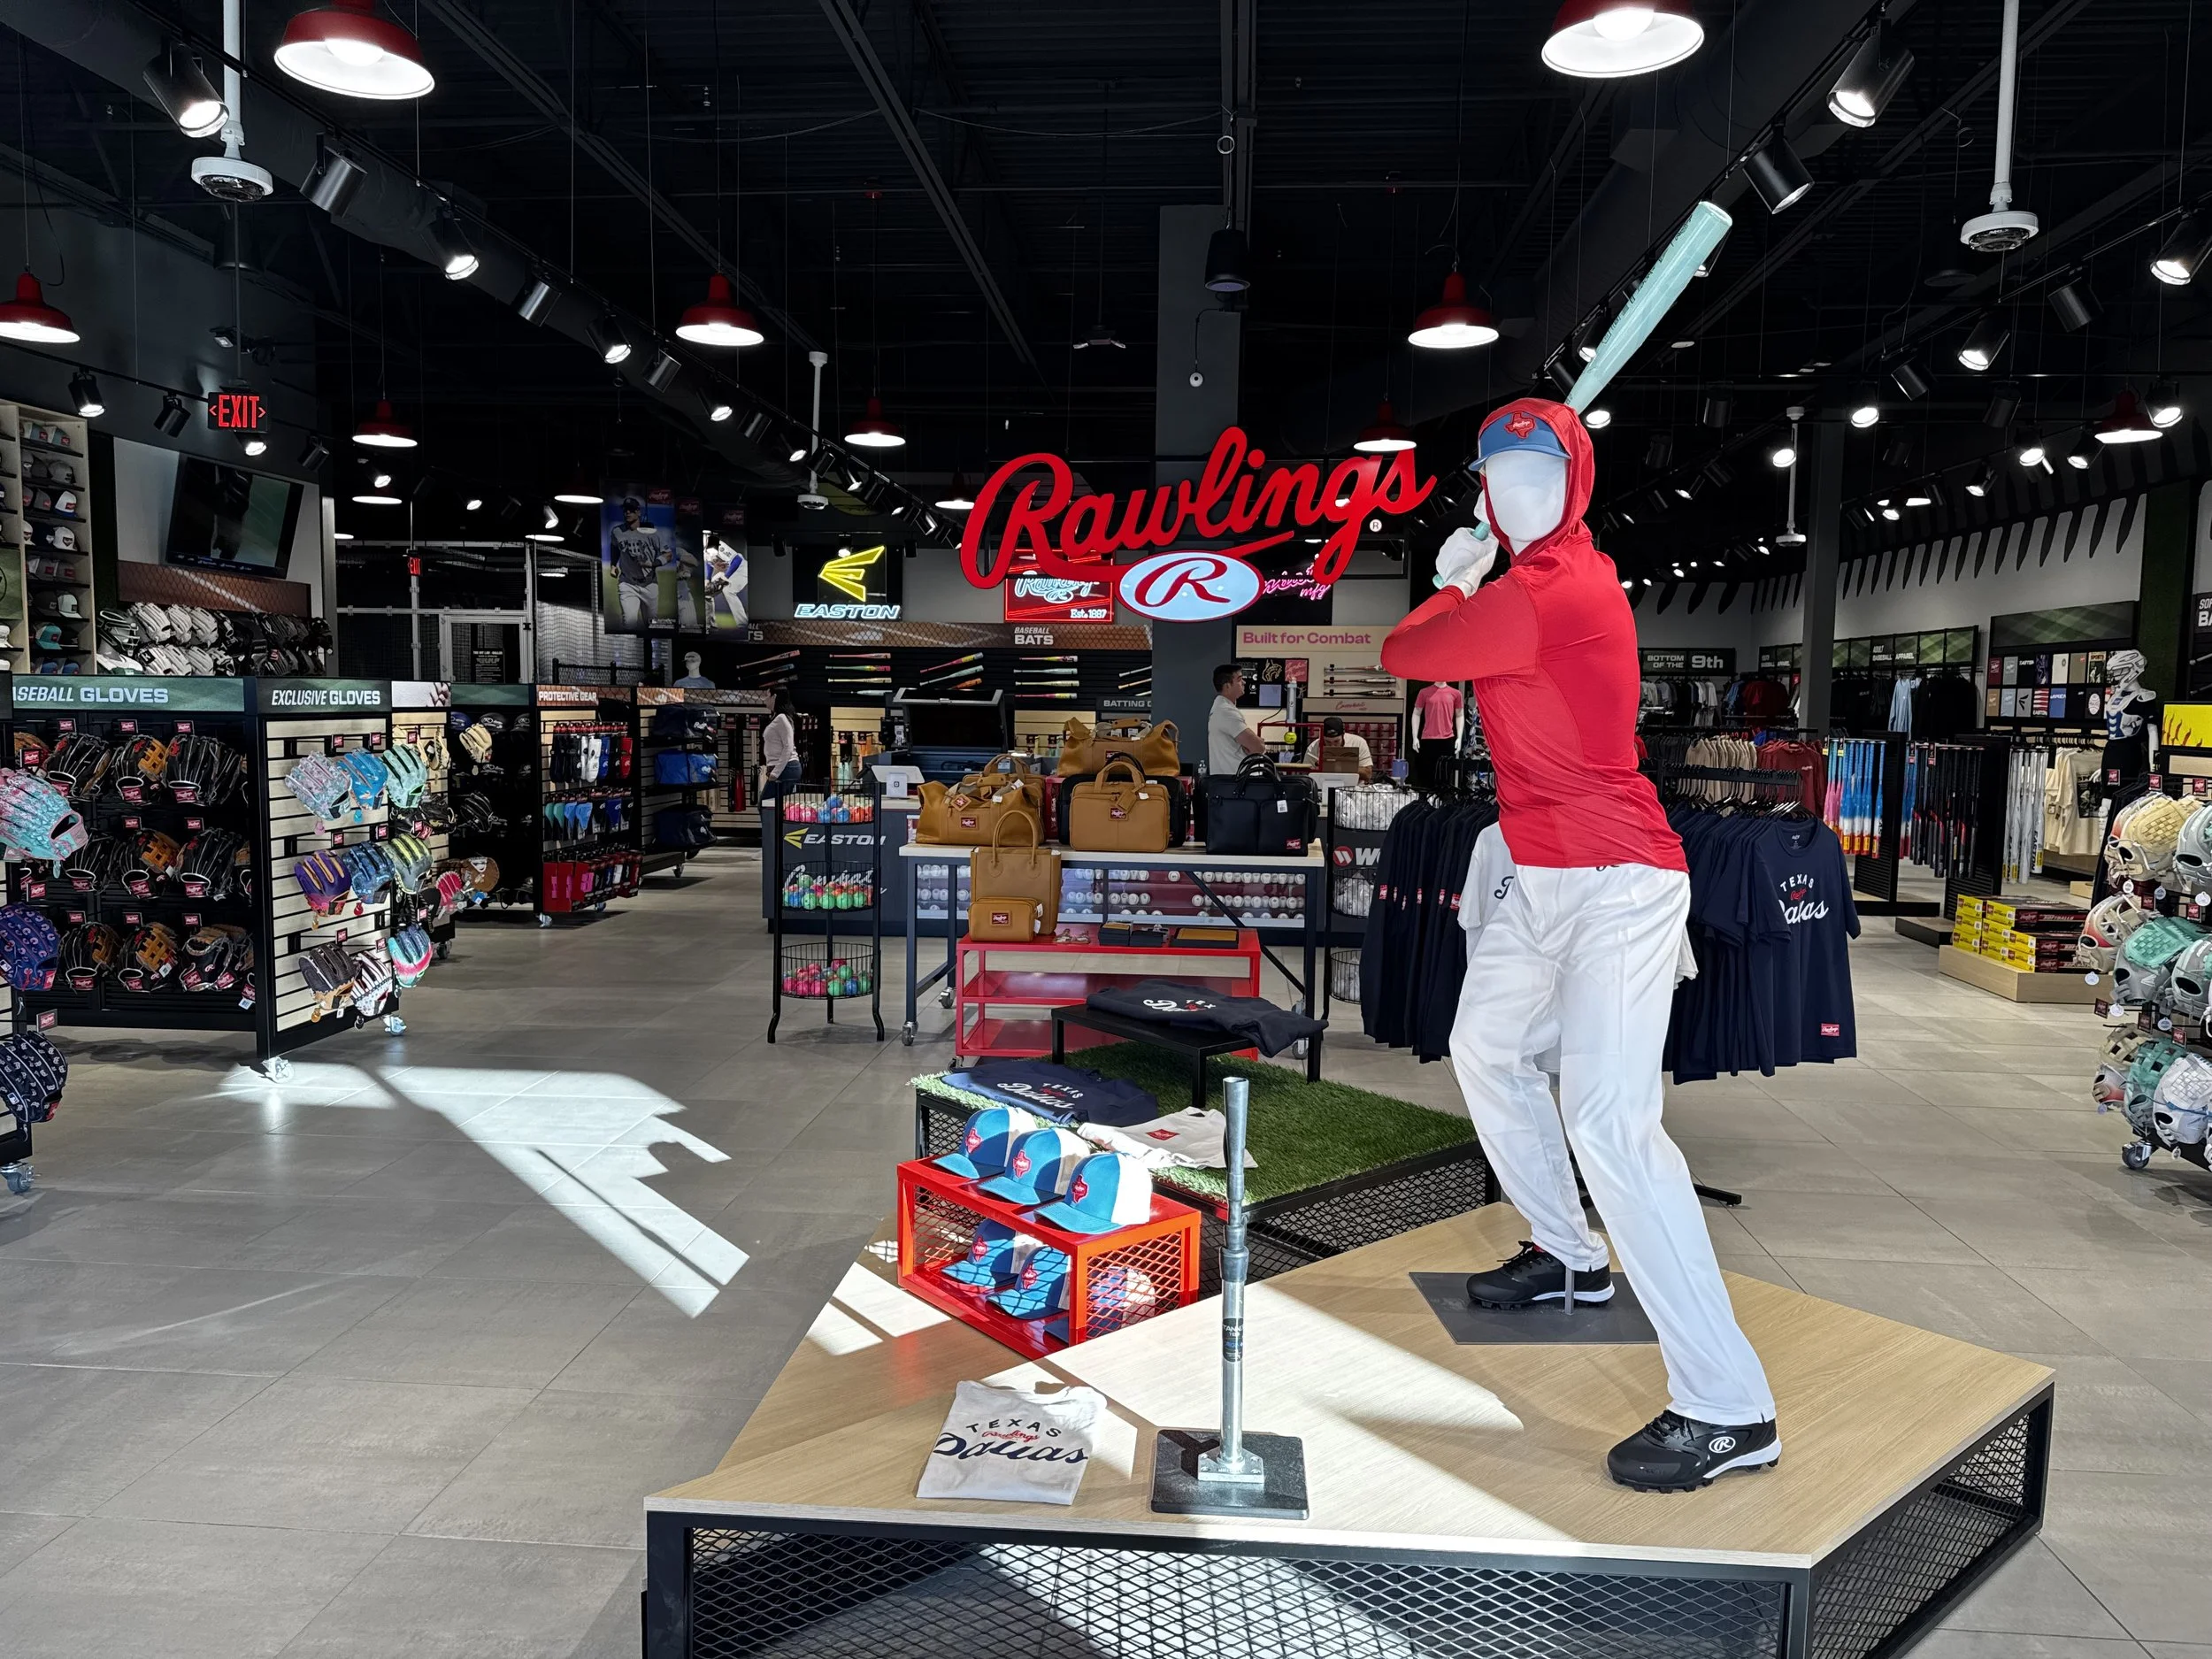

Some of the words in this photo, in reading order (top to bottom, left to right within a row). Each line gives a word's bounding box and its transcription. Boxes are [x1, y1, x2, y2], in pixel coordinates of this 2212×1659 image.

[218, 395, 259, 428] EXIT
[960, 426, 1439, 589] Rawlings
[409, 557, 421, 575] EXIT
[794, 603, 901, 619] EASTON
[1070, 609, 1088, 618] Est.
[1088, 609, 1107, 618] 1887
[1014, 634, 1054, 645] BATS
[1243, 632, 1278, 644] Built
[1280, 632, 1305, 644] for
[1307, 632, 1371, 644] Combat
[1691, 655, 1724, 669] 9th
[12, 686, 74, 702] SEBALL
[80, 687, 169, 703] GLOVES
[271, 689, 327, 706] EXCLUSIVE
[329, 690, 380, 705] GLOVES
[538, 691, 579, 702] PROTECTIVE
[580, 691, 597, 702] GEAR
[803, 833, 887, 846] EASTON
[1780, 874, 1815, 893] TEXAS
[1042, 1082, 1084, 1099] TEXAS
[965, 1418, 1062, 1438] TEXAS
[982, 1430, 1041, 1443] Rawlings
